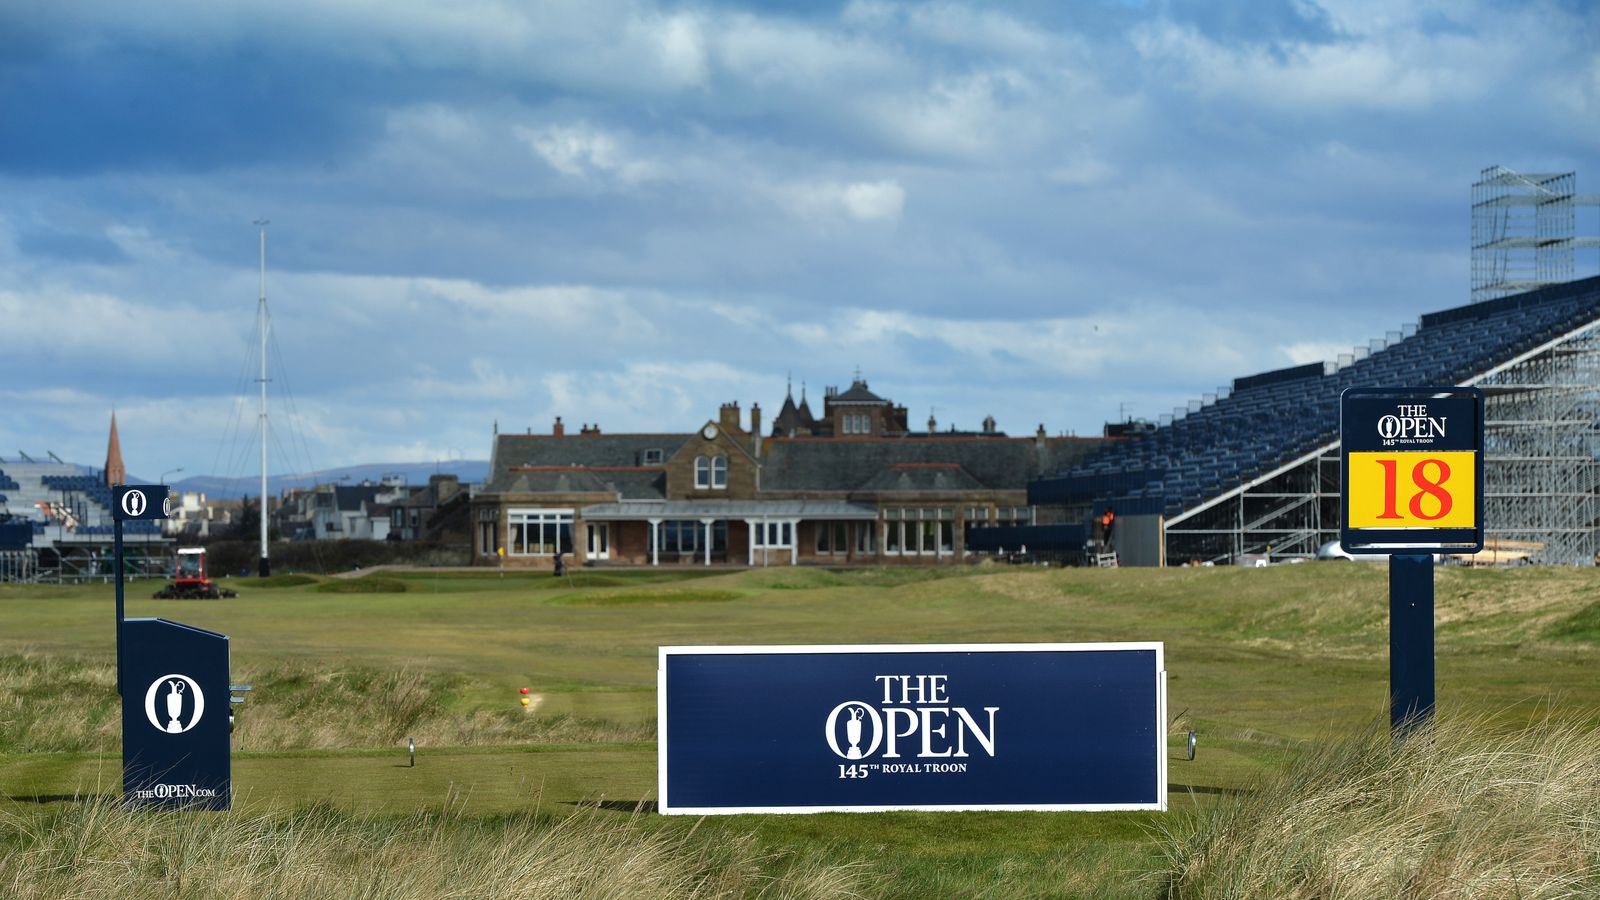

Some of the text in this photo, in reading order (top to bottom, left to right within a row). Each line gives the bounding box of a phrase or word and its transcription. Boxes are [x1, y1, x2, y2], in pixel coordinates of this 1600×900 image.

[1397, 404, 1428, 417] THE
[1377, 414, 1448, 438] OPEN
[1375, 458, 1453, 521] 18
[875, 674, 950, 704] THE
[825, 700, 1000, 760] OPEN
[882, 763, 922, 773] ROYAL
[923, 763, 968, 773] TROON
